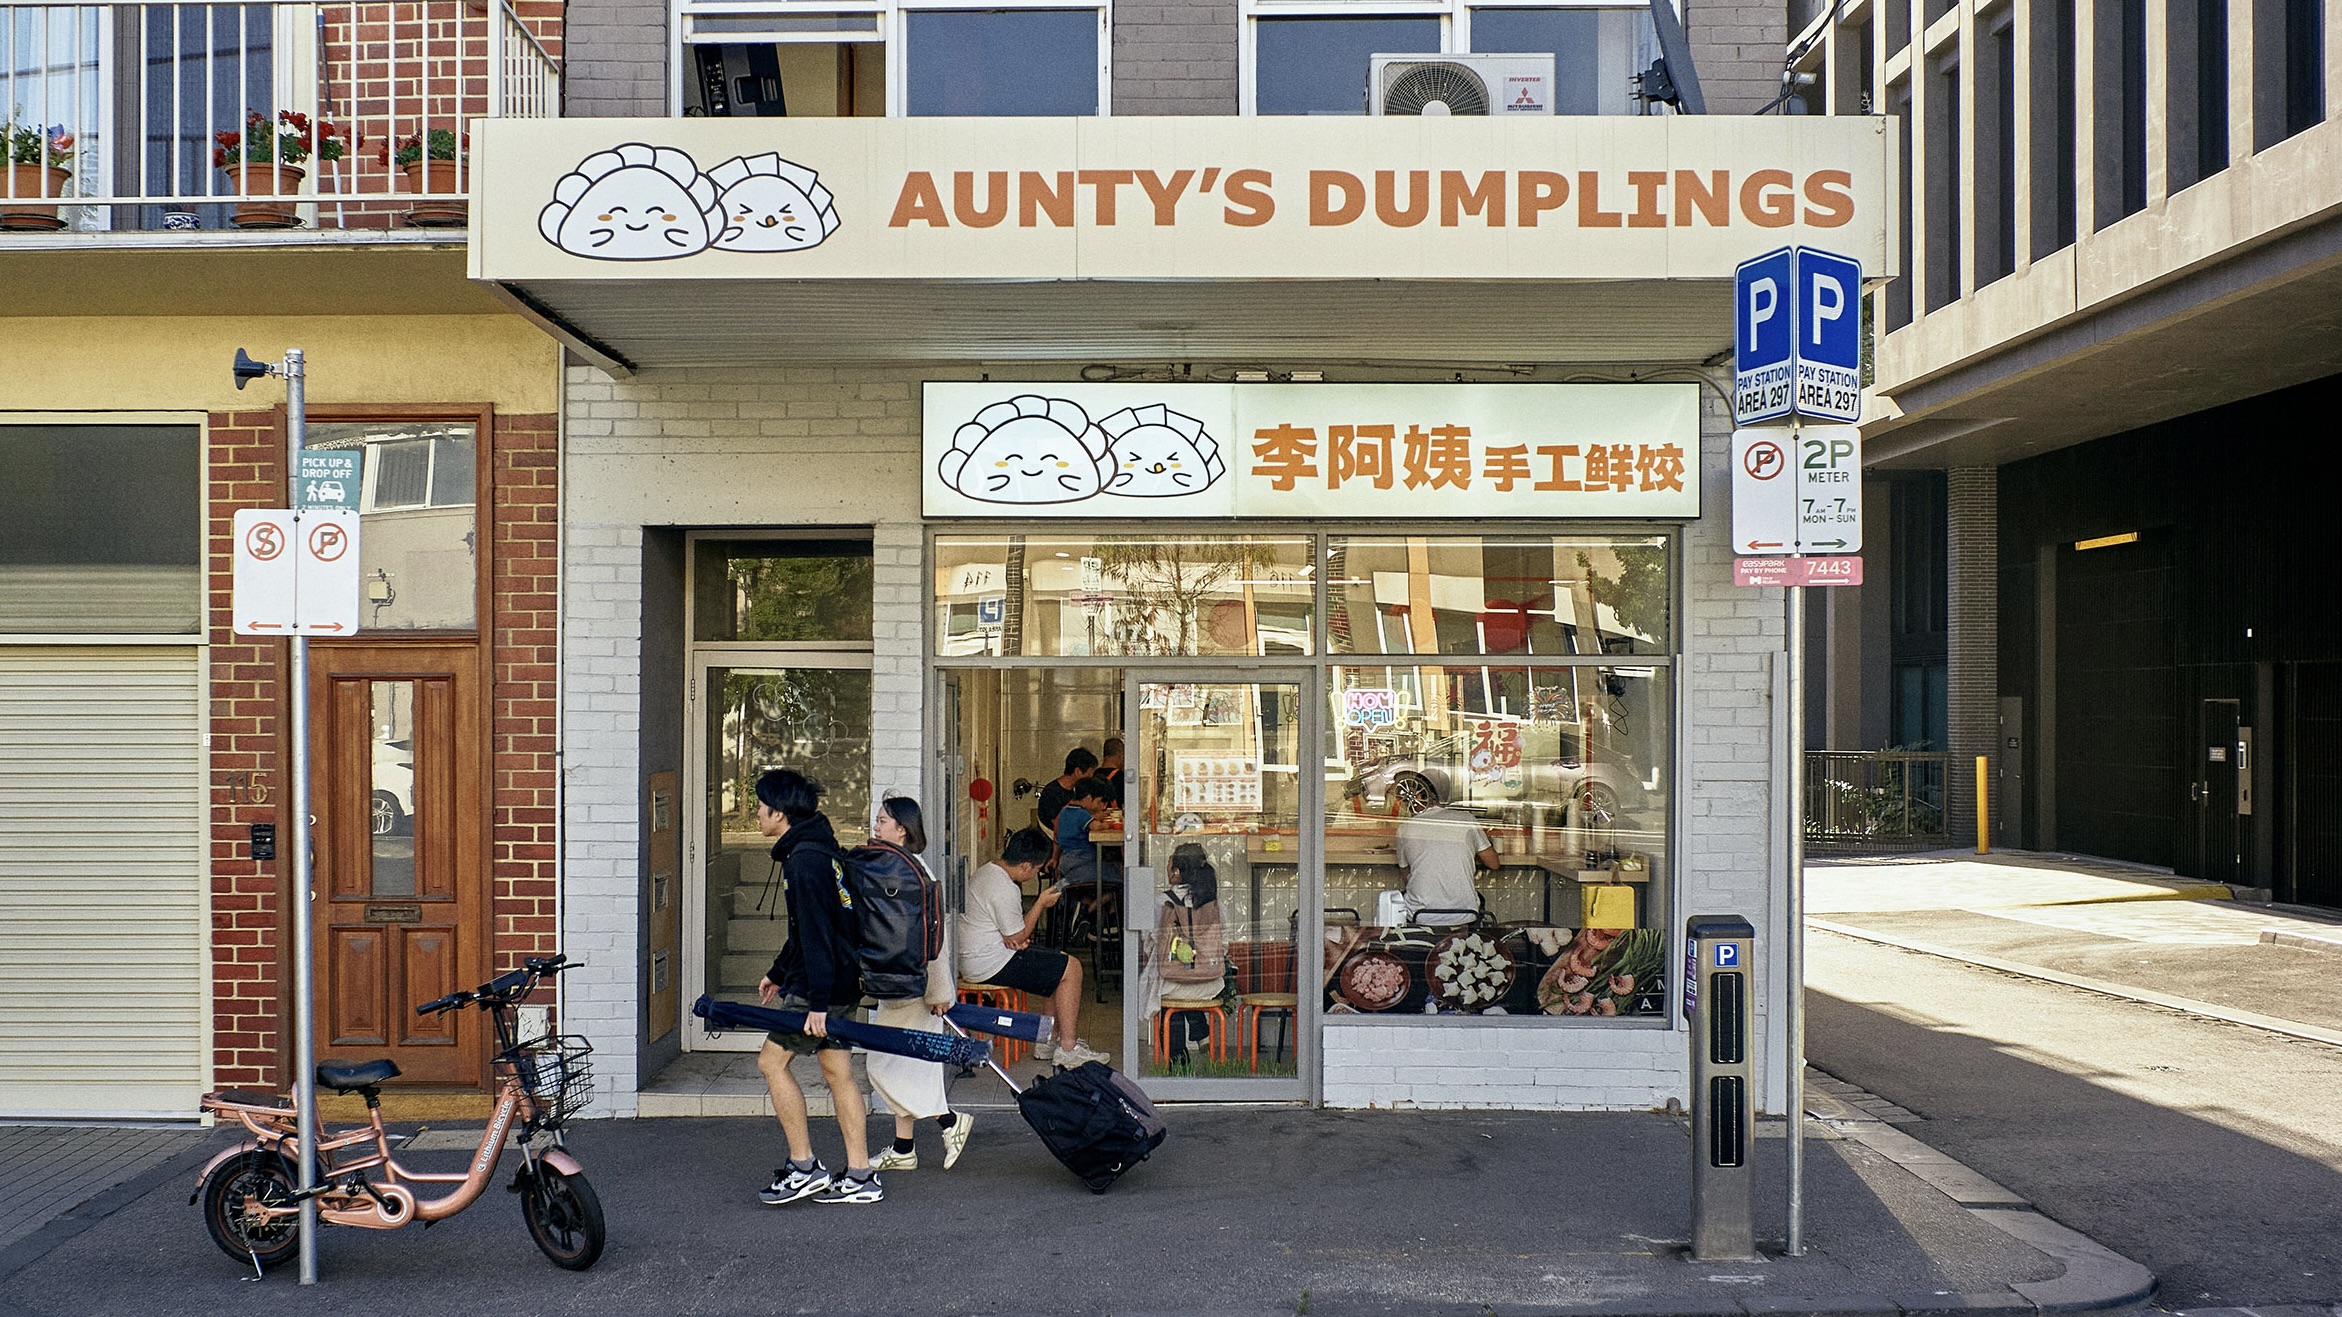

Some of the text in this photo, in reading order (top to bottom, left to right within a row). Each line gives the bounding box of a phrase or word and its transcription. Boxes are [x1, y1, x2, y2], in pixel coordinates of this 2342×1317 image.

[888, 167, 1855, 228] AUNTY'S DUMPLINGS
[1750, 277, 1778, 352] P
[1813, 272, 1845, 345] P
[1738, 365, 1791, 391] PAY STATION
[1799, 365, 1857, 389] PAY STATION
[1738, 383, 1790, 415] AREA 297
[1799, 383, 1857, 412] AREA 297
[302, 458, 327, 467] PICK
[1803, 440, 1854, 469] 2P
[302, 469, 353, 478] DROP OFF
[1809, 472, 1849, 483] METER
[1803, 515, 1826, 523] MON
[1836, 515, 1856, 523] SUN
[1807, 560, 1851, 575] 7443
[1348, 692, 1394, 709] NOW
[1348, 709, 1394, 724] OPEN
[1471, 720, 1522, 768] 福
[1720, 945, 1734, 965] P
[480, 1100, 511, 1163] Lithium Bicycle
